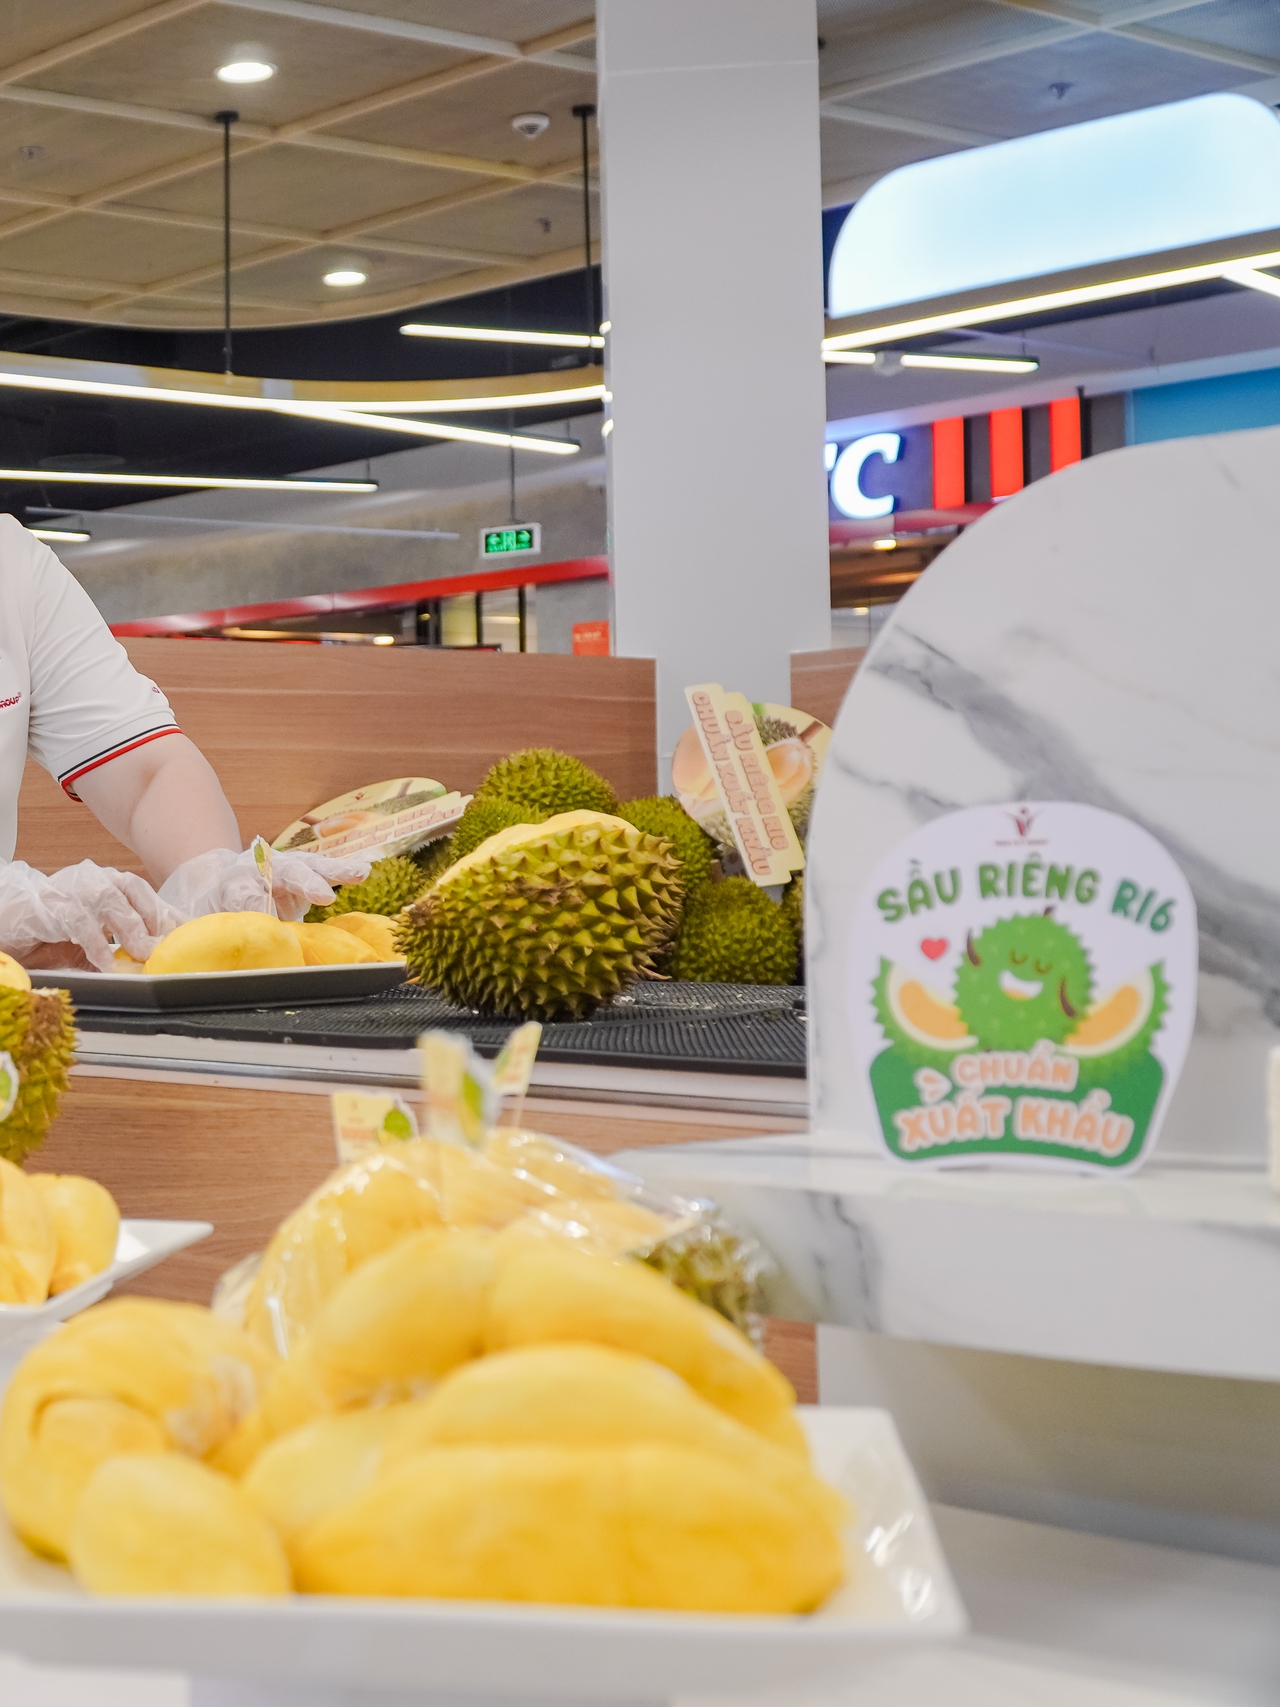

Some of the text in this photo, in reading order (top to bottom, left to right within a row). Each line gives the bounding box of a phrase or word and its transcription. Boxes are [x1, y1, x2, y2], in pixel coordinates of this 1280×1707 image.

[877, 858, 961, 922] SẦU
[978, 852, 1100, 904] RIÊNG
[952, 1040, 1078, 1090] CHUẨN
[896, 1080, 1132, 1154] XUẤT KHẨU
